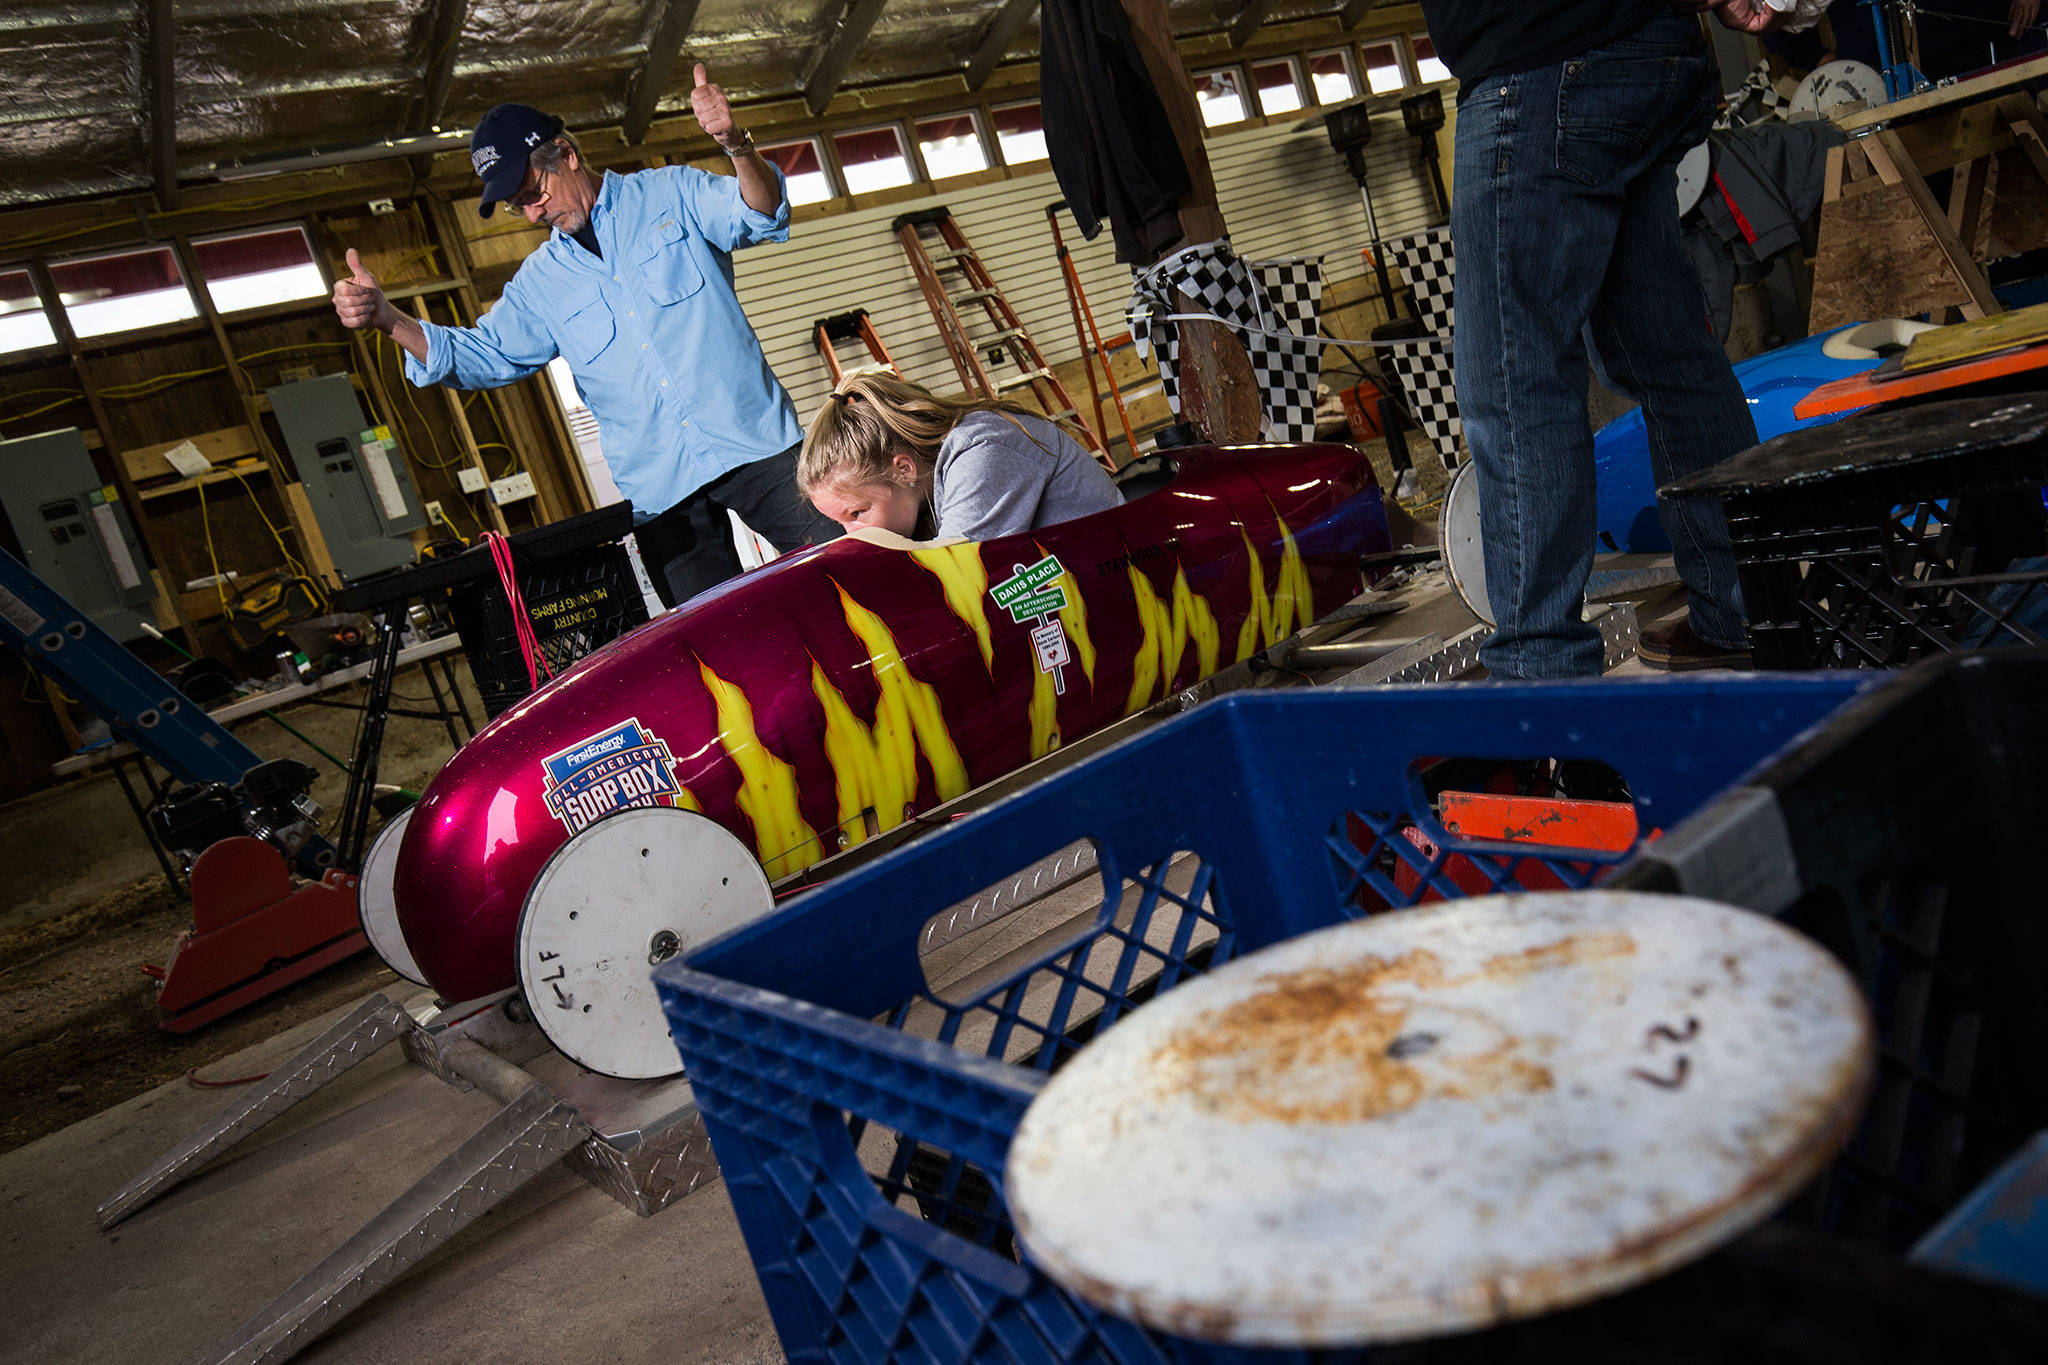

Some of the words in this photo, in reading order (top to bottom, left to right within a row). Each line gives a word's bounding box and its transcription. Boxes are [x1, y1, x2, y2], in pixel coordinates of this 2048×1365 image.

[997, 580, 1028, 601] DAVIS
[1027, 562, 1058, 585] PLACE
[530, 600, 566, 620] FARMS
[1014, 603, 1024, 612] AN
[1023, 592, 1061, 609] AFTERSCHOOL
[1022, 600, 1058, 617] DESTINATION
[554, 607, 597, 630] COUNTRY
[553, 747, 664, 806] ALL-AMERICAN
[564, 778, 619, 831] SOAP
[616, 758, 671, 800] BOX
